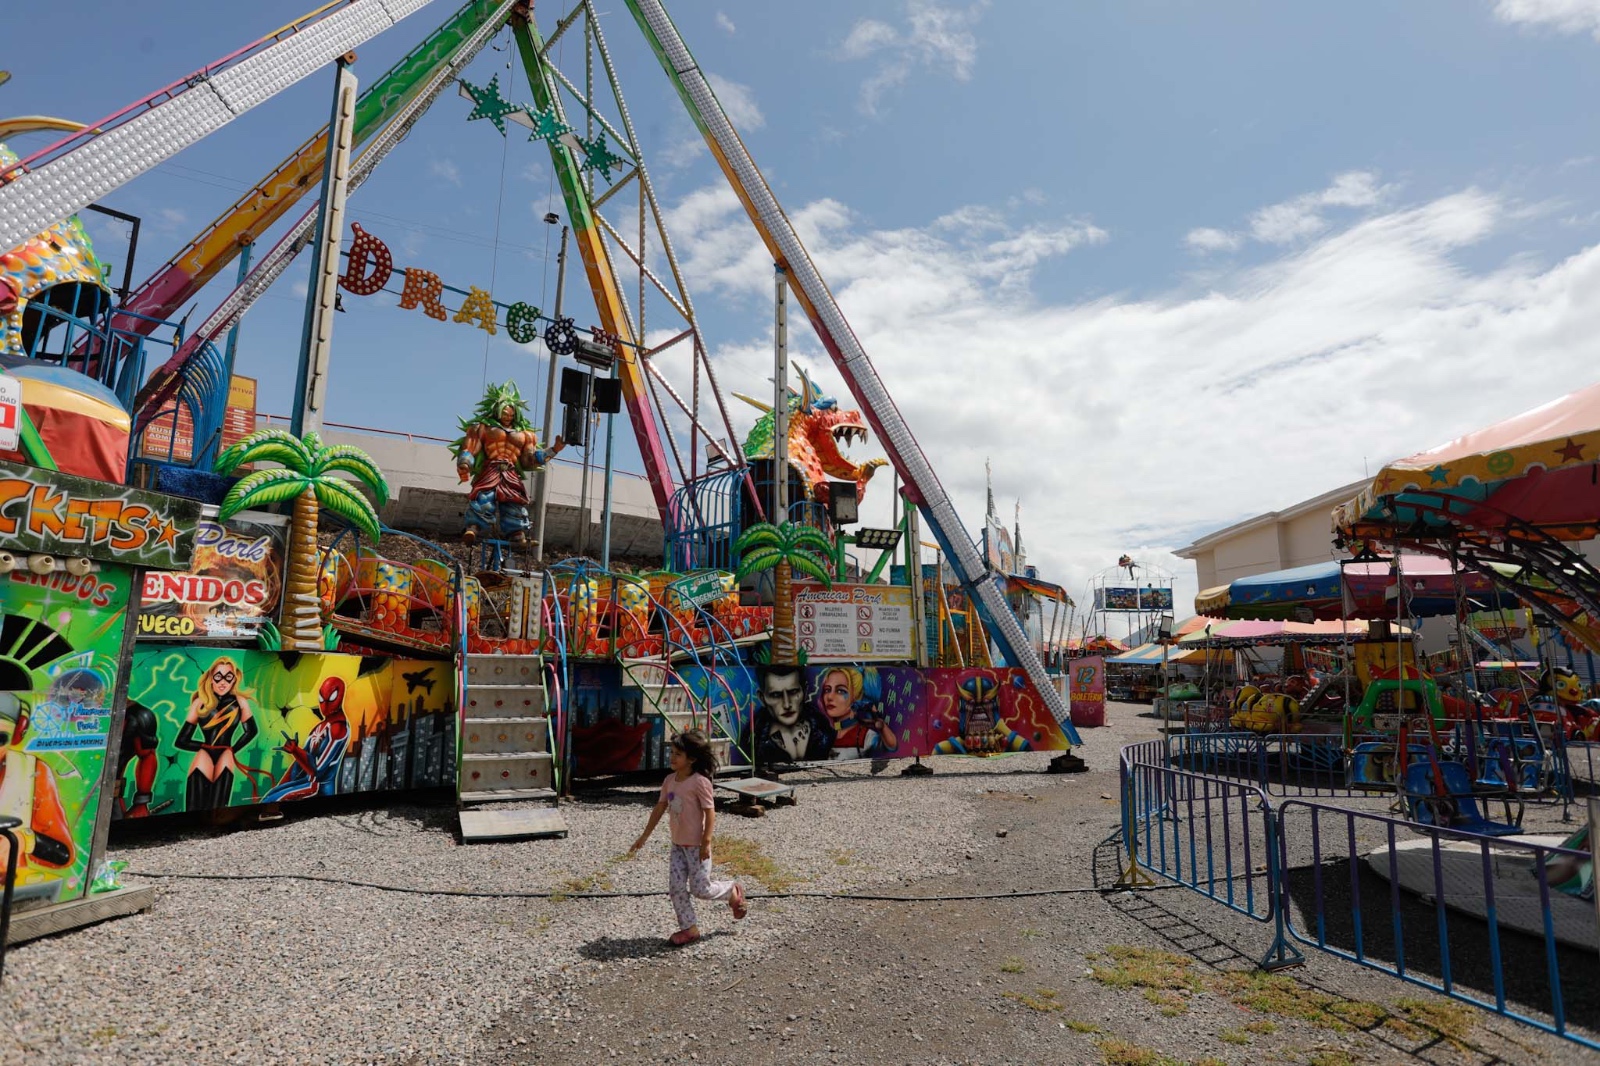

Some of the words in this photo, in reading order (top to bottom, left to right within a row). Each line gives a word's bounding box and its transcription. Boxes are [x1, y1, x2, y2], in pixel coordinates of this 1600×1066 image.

[141, 571, 266, 605] ENIDOS
[797, 587, 849, 602] American
[853, 588, 882, 604] Park
[682, 587, 722, 609] ERGENCIA
[1077, 667, 1095, 683] 12
